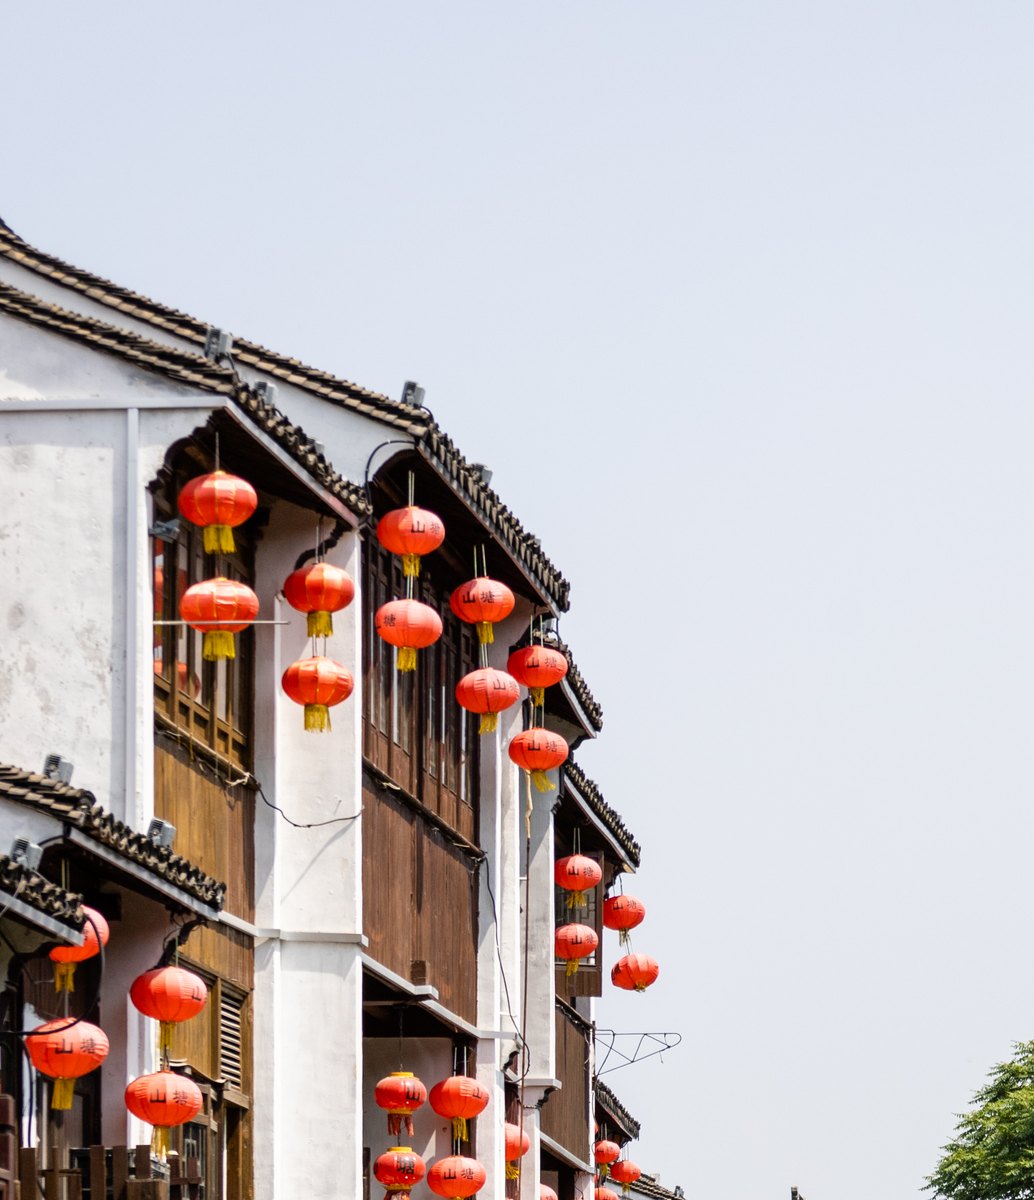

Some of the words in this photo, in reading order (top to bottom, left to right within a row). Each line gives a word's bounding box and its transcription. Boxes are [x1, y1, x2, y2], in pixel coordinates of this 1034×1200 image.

[410, 520, 441, 536] 山塘
[462, 590, 495, 605] 山塘
[526, 656, 557, 669] 山塘
[528, 739, 558, 753] 山塘
[568, 865, 594, 878] 山塘
[55, 1038, 96, 1055] 山塘
[150, 1088, 188, 1106] 山塘
[443, 1167, 474, 1181] 山塘
